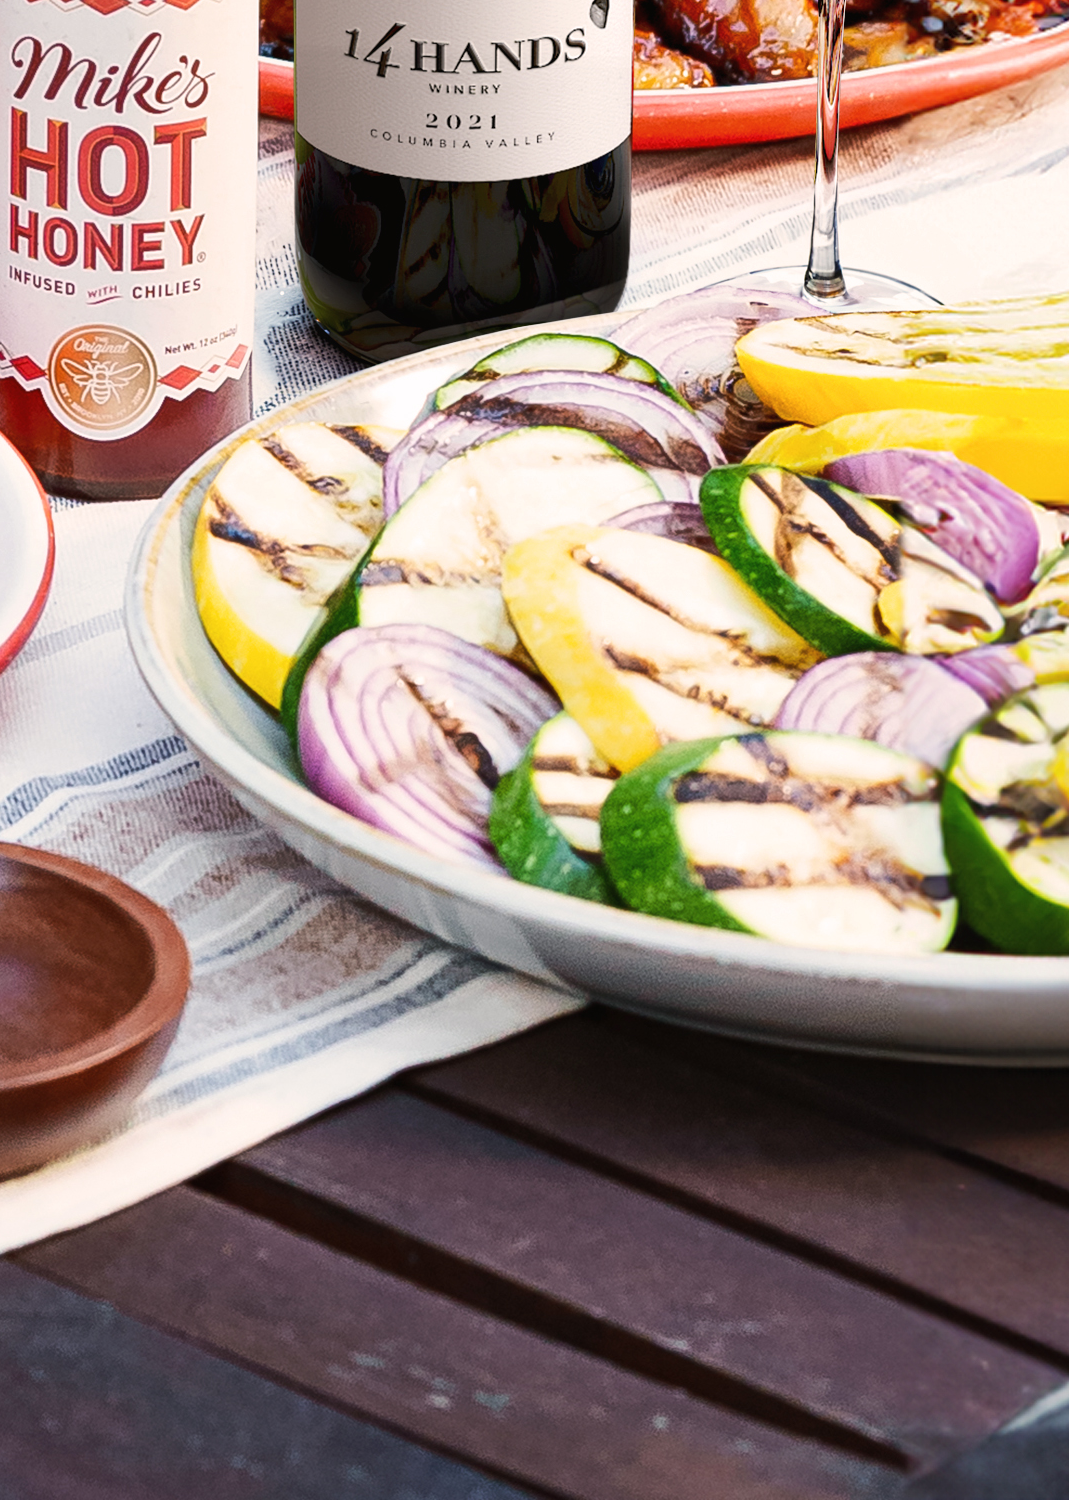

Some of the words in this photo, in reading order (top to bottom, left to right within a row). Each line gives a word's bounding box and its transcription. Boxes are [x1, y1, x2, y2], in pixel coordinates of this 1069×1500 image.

[344, 22, 406, 78] 14
[410, 27, 587, 75] HANDS
[11, 32, 216, 114] Mike's
[429, 83, 502, 95] WINERY
[425, 113, 498, 130] 2021
[370, 128, 472, 149] COLUMBIA
[485, 131, 556, 149] VALLEY
[10, 106, 208, 217] HOT
[8, 265, 76, 296] INFUSED
[87, 285, 118, 299] WITH
[132, 278, 202, 299] CHILIES
[73, 338, 131, 359] Original
